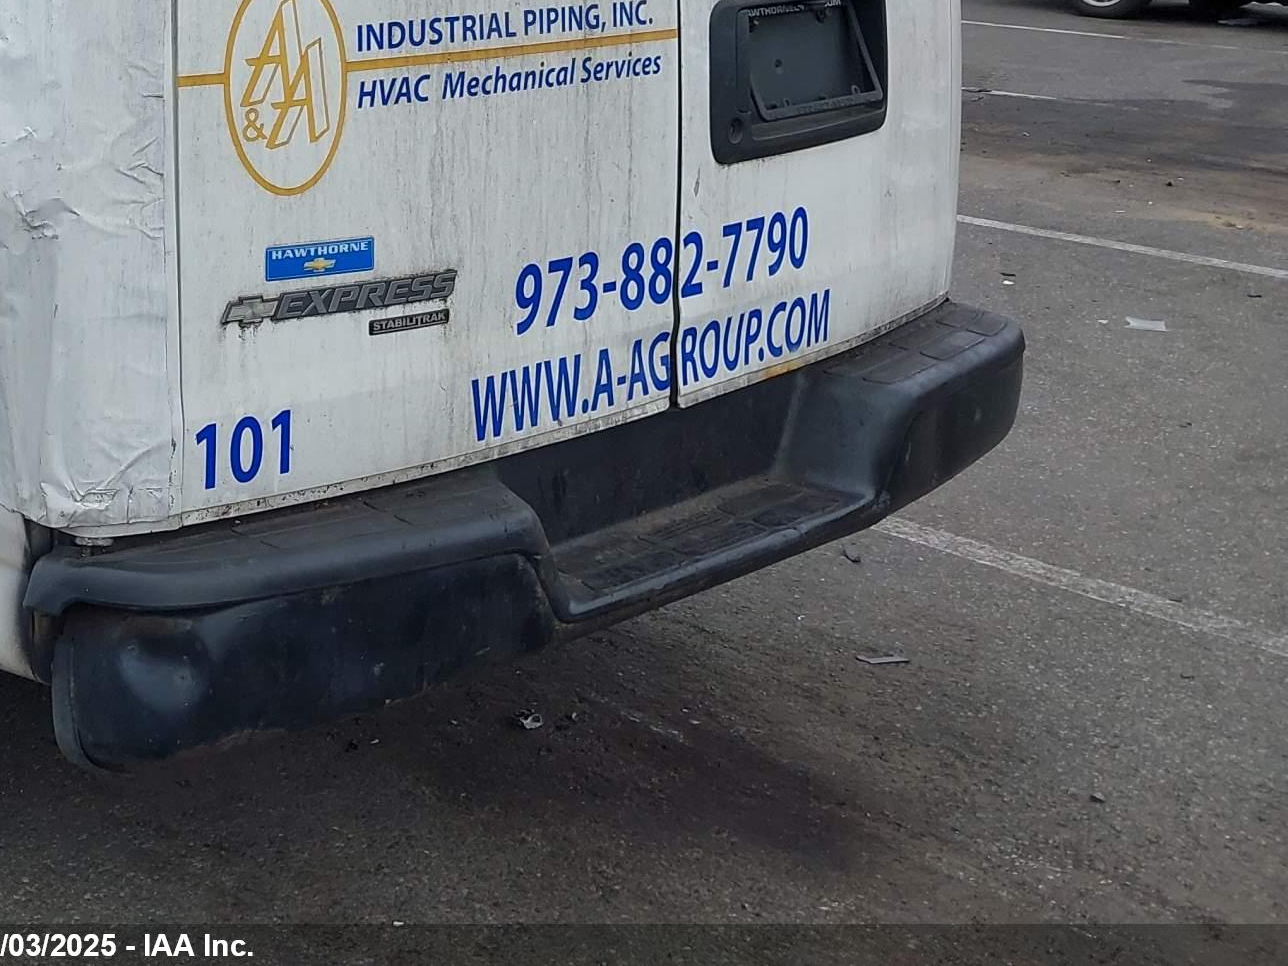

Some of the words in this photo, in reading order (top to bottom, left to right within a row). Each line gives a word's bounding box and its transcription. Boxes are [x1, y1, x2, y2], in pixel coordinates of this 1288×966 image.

[357, 13, 516, 52] INDUSTRIAL
[523, 3, 606, 37] PIPING,
[613, 0, 654, 28] INC.
[358, 74, 430, 109] HVAC
[442, 56, 575, 100] Mechanical
[579, 51, 662, 83] Services
[271, 241, 369, 260] HAWTHORNE
[515, 206, 809, 336] 973-882-7790
[275, 270, 458, 320] EXPRESS
[373, 312, 446, 331] STABILITRAK
[471, 289, 831, 442] WWW.A-AGROUP.COM
[195, 409, 291, 490] 101
